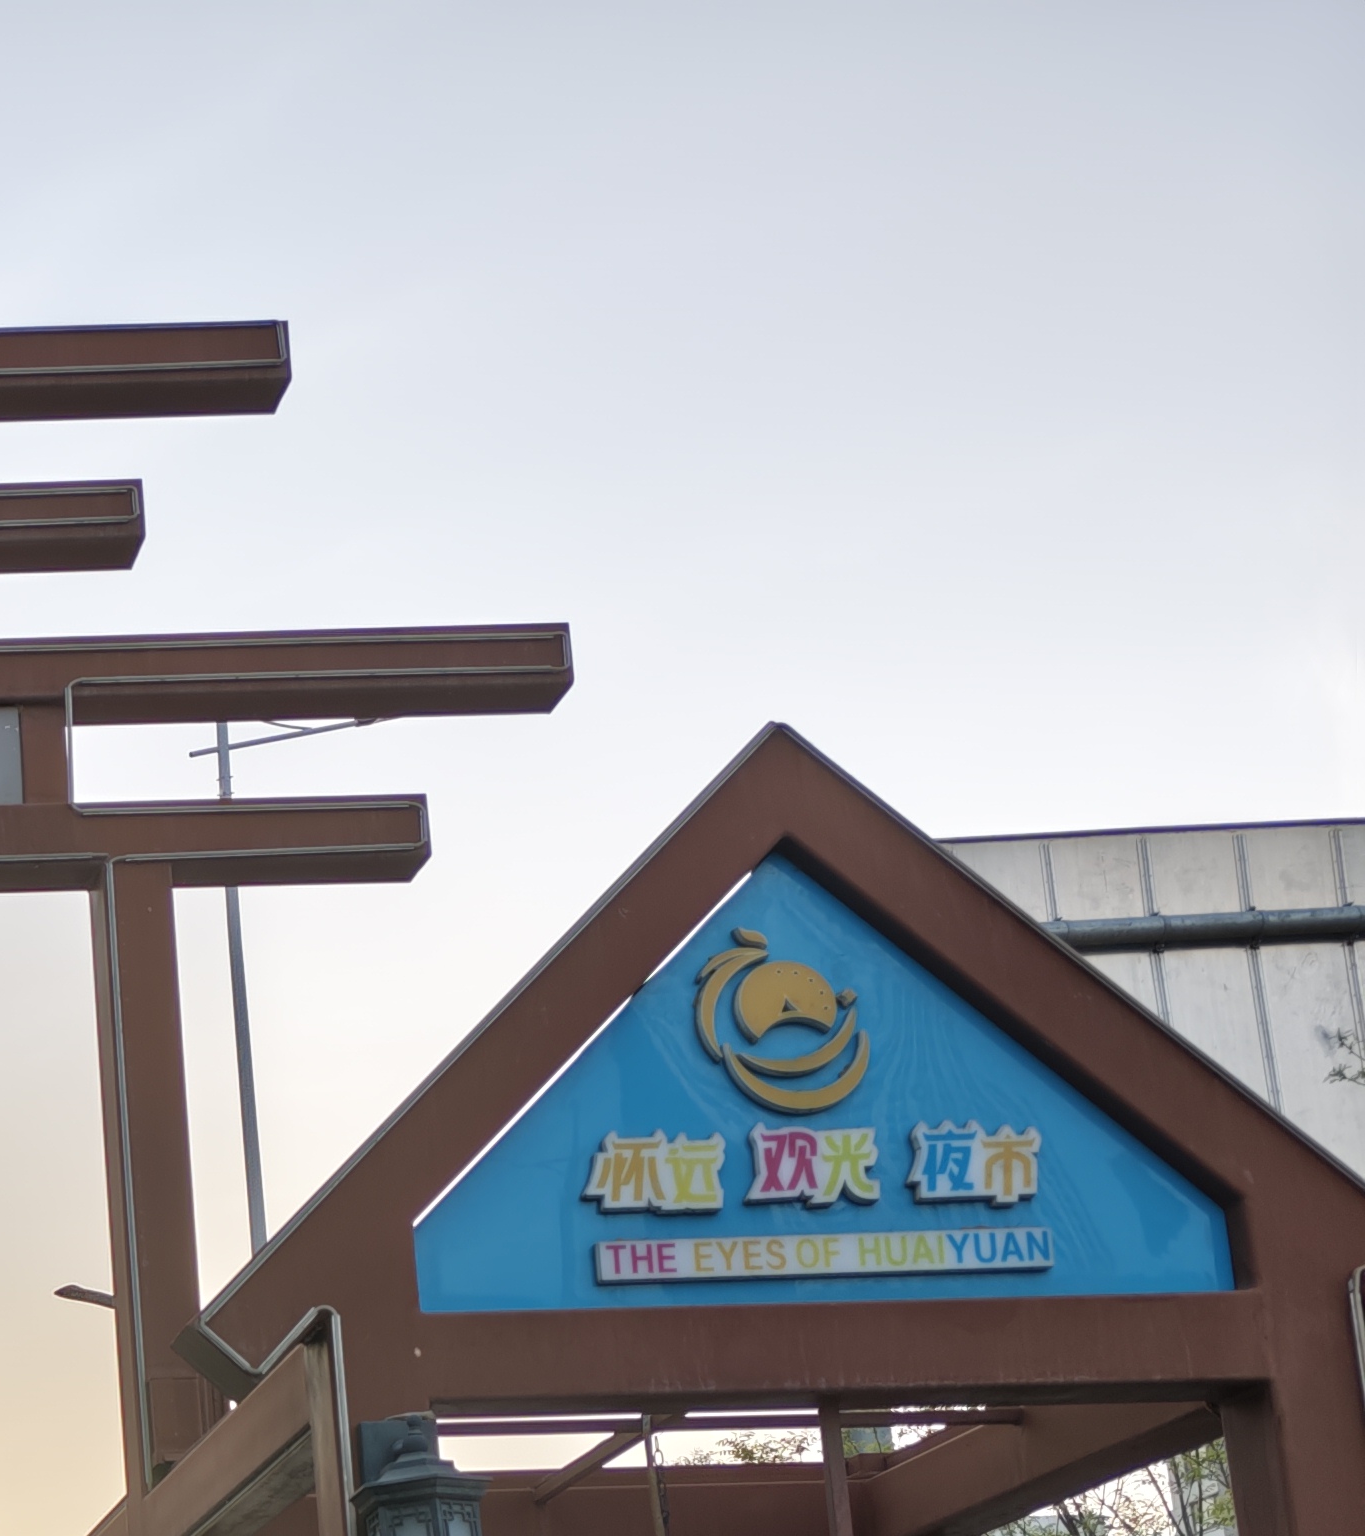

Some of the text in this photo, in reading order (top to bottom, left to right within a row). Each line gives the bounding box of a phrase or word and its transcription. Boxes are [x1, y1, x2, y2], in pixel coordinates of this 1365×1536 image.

[606, 1230, 1051, 1274] THE EYES OF HUAIYUAN
